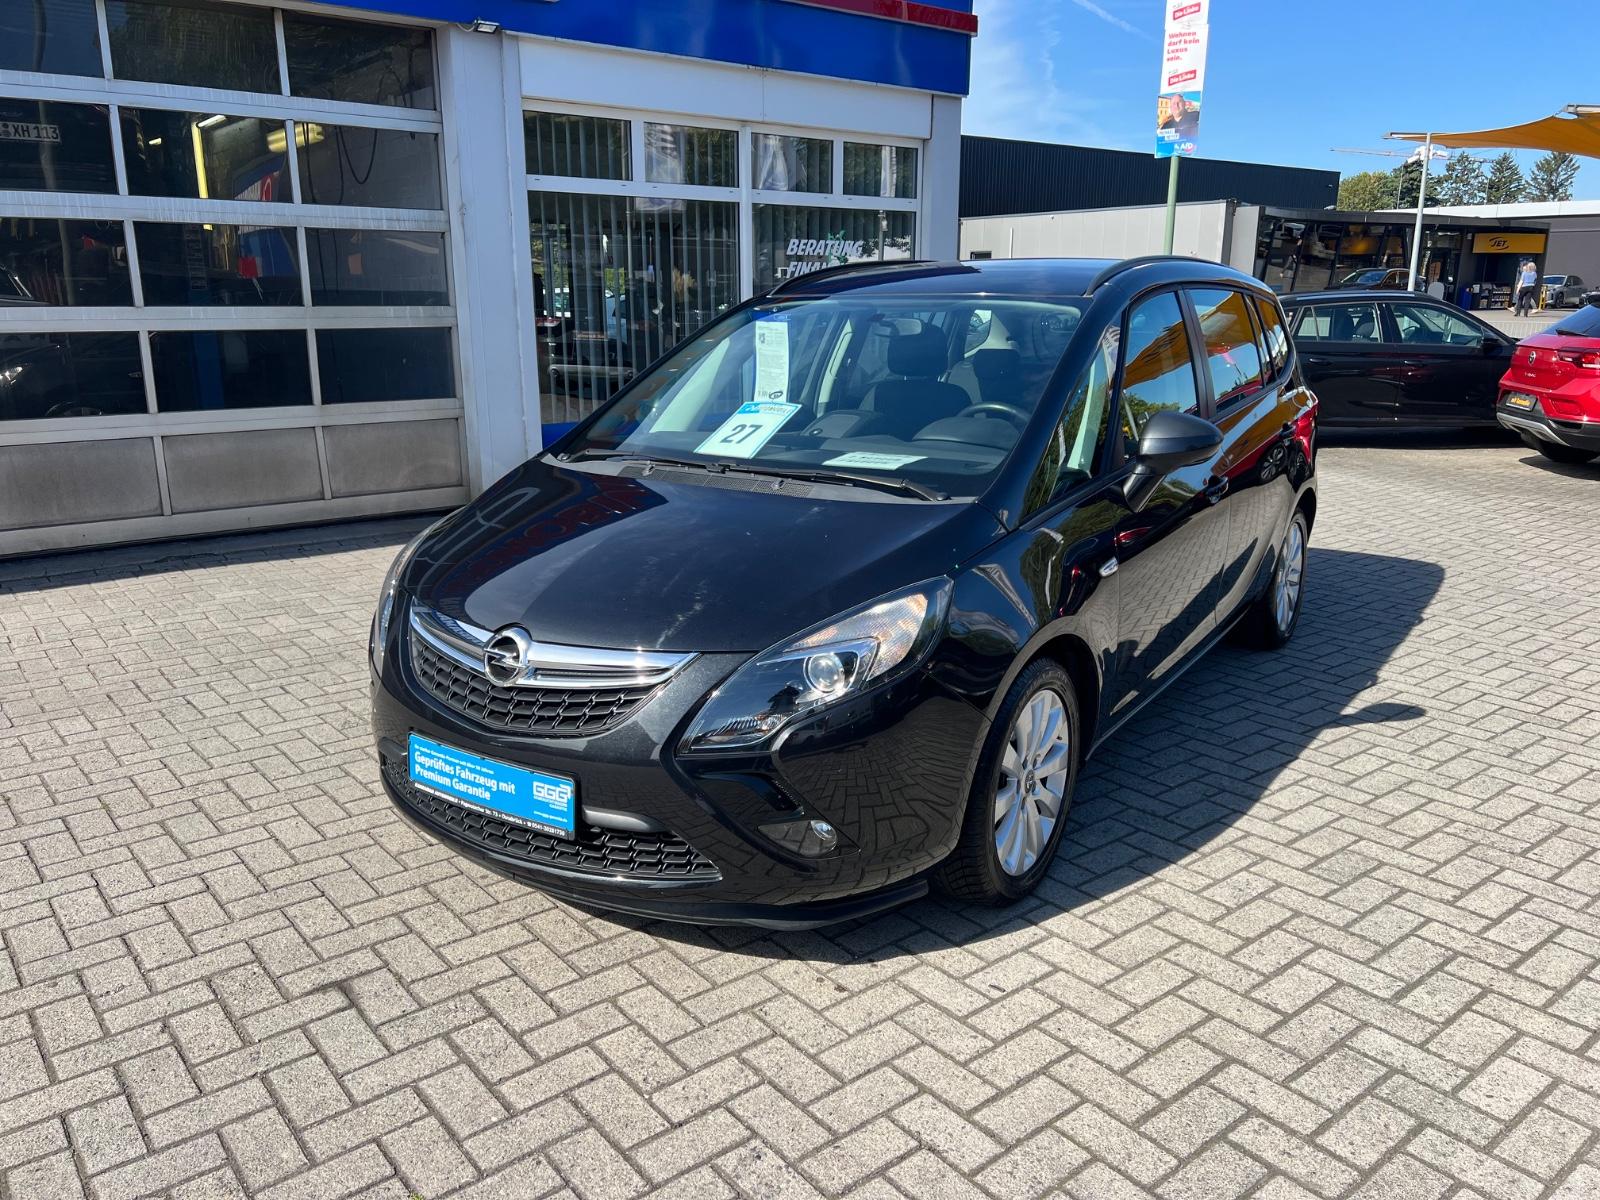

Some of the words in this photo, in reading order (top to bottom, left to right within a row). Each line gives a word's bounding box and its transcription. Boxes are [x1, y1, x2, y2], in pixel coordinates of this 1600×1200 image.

[12, 124, 31, 138] XH
[33, 125, 59, 140] 113
[786, 239, 864, 257] BERATUNG
[1490, 240, 1507, 248] JET
[719, 423, 763, 444] 27
[414, 751, 454, 774] Geprüftes
[456, 767, 497, 791] Fahrzeug
[499, 782, 516, 795] mit
[415, 764, 451, 787] Premium
[453, 778, 491, 800] Garantie
